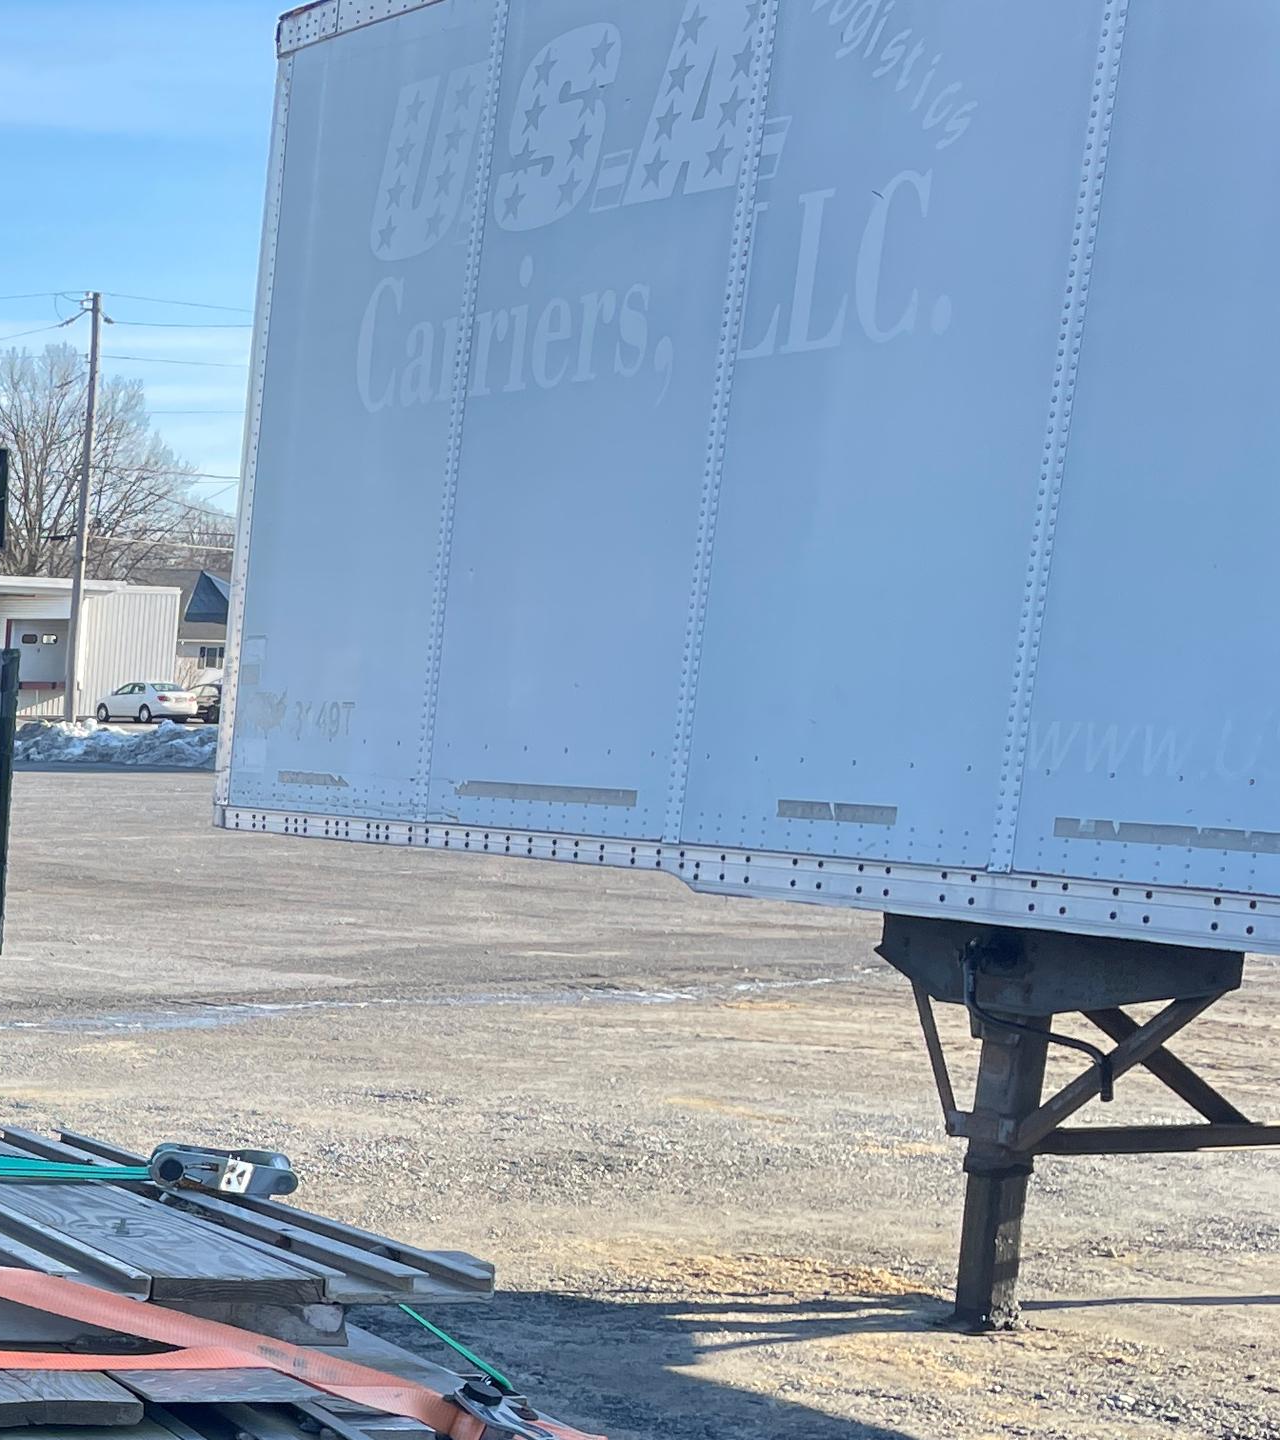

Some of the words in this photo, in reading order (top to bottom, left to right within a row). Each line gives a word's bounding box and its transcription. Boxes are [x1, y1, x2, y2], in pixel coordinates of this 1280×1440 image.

[813, 0, 978, 150] ogistics
[356, 253, 675, 413] Carriers,
[734, 168, 955, 360] LLC.
